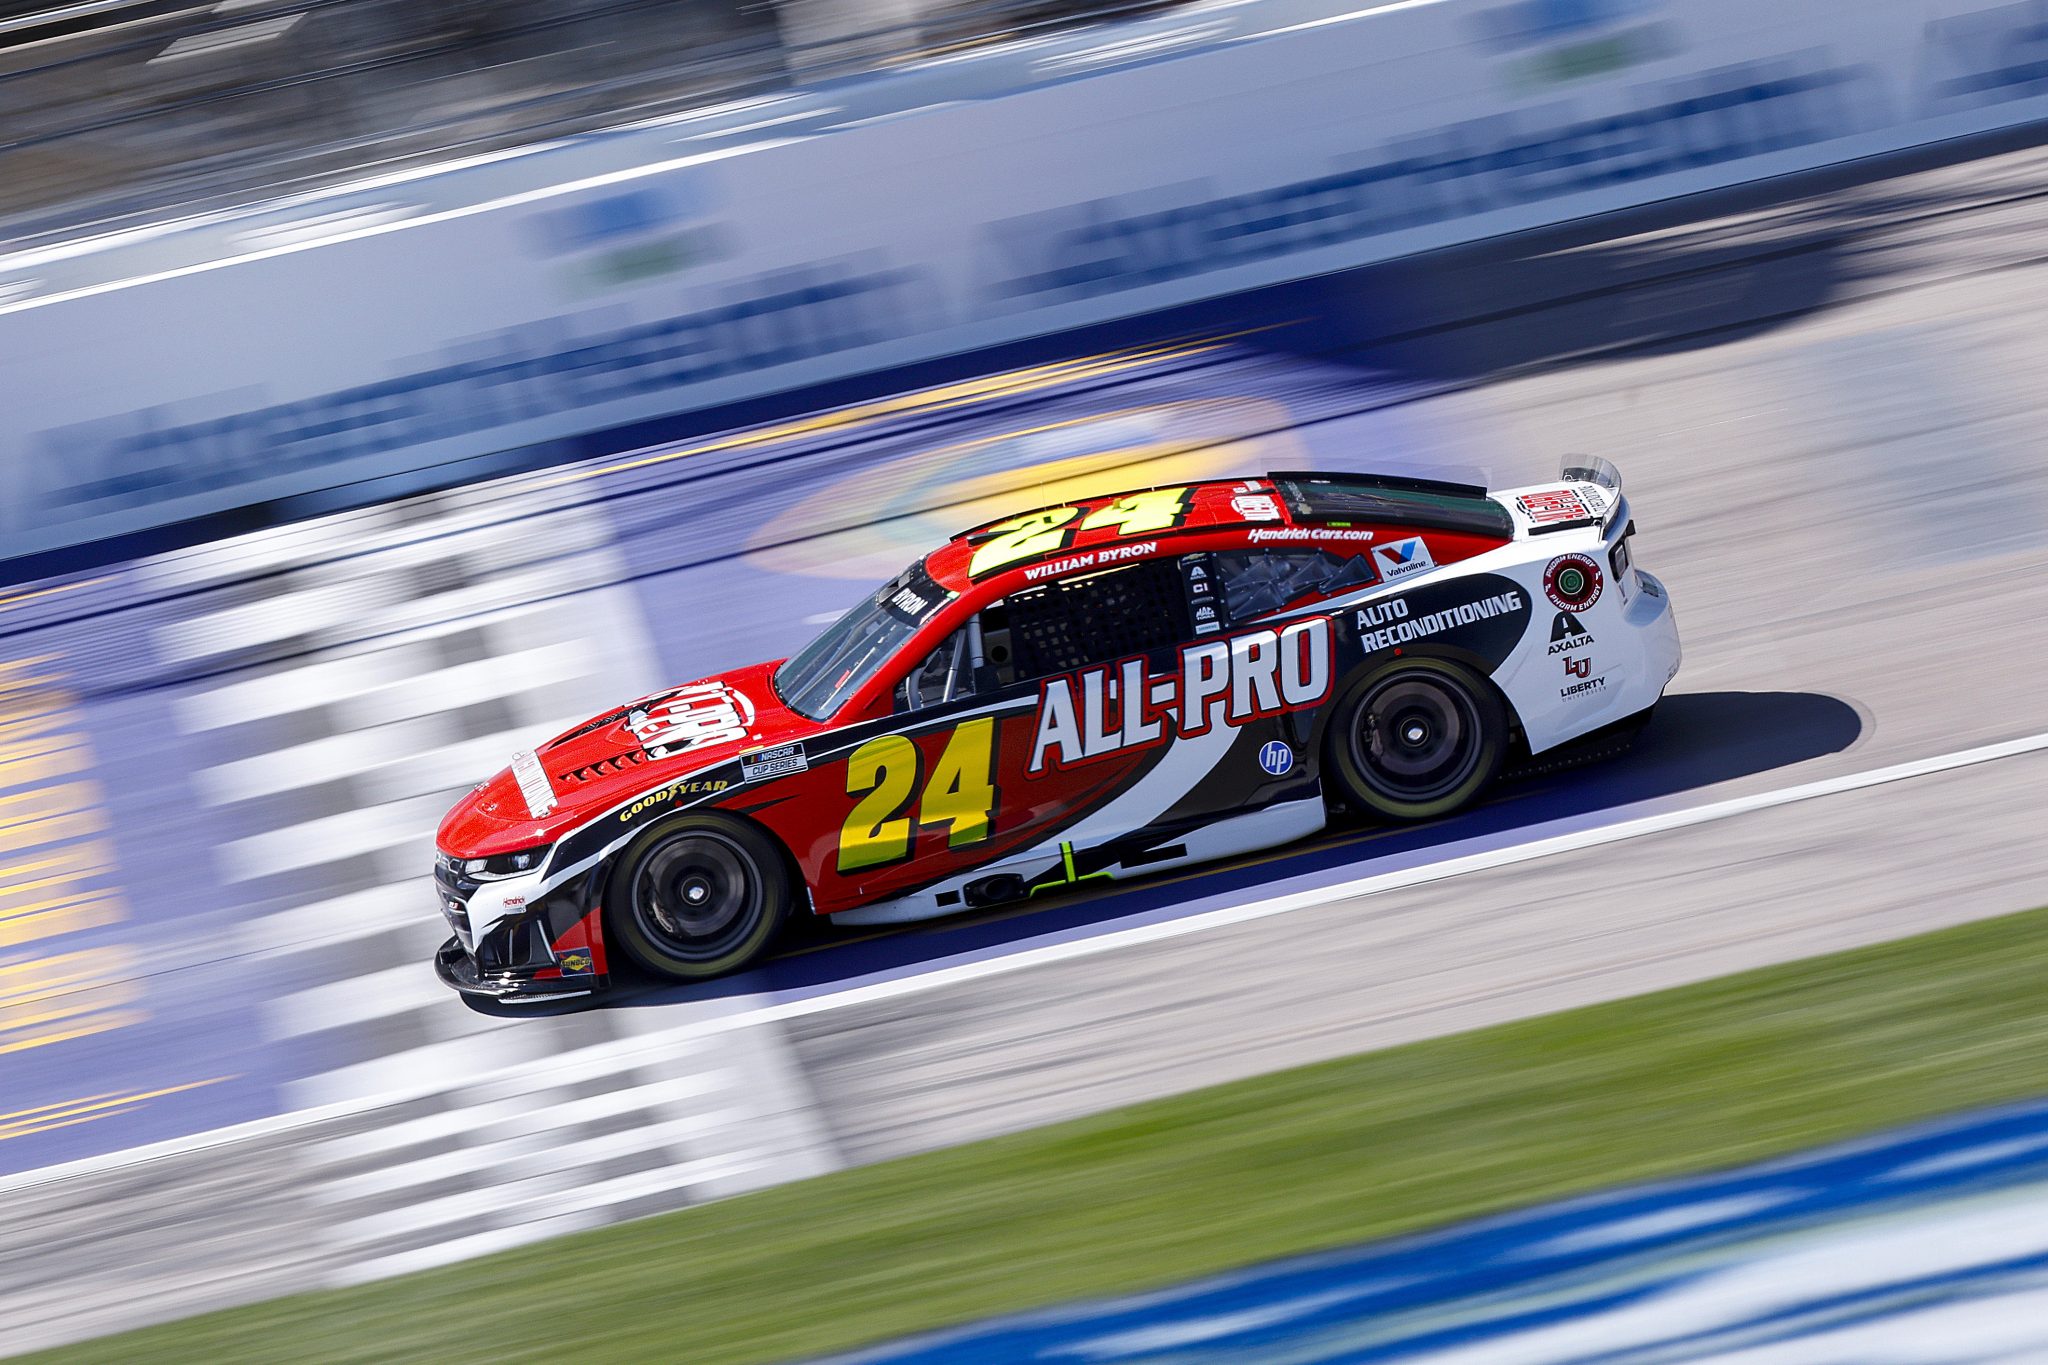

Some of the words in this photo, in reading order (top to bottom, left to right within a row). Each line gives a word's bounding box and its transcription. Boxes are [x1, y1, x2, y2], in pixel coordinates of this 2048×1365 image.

[968, 487, 1187, 578] 24
[1024, 553, 1094, 581] WILLIAM
[1099, 542, 1157, 563] BYRON
[1387, 560, 1426, 577] Valvoline
[1546, 555, 1566, 577] PHORM
[1567, 553, 1596, 567] ENERGY
[891, 588, 928, 616] BYRON
[1549, 593, 1577, 610] PHORM
[1578, 584, 1601, 610] ENERGY
[1357, 598, 1409, 630] AUTO
[1361, 590, 1522, 653] RECONDITIONING
[1548, 635, 1594, 655] AXALTA
[1563, 656, 1591, 678] LU
[1029, 617, 1330, 774] ALL-PRO
[1560, 676, 1606, 697] LIBERTY
[752, 764, 769, 775] CUP
[769, 758, 798, 772] SERIES
[761, 747, 794, 761] NASCAR
[1265, 742, 1288, 774] hp
[619, 779, 728, 822] GOODYEAR
[838, 717, 994, 872] 24
[561, 957, 592, 968] SUNOCO
